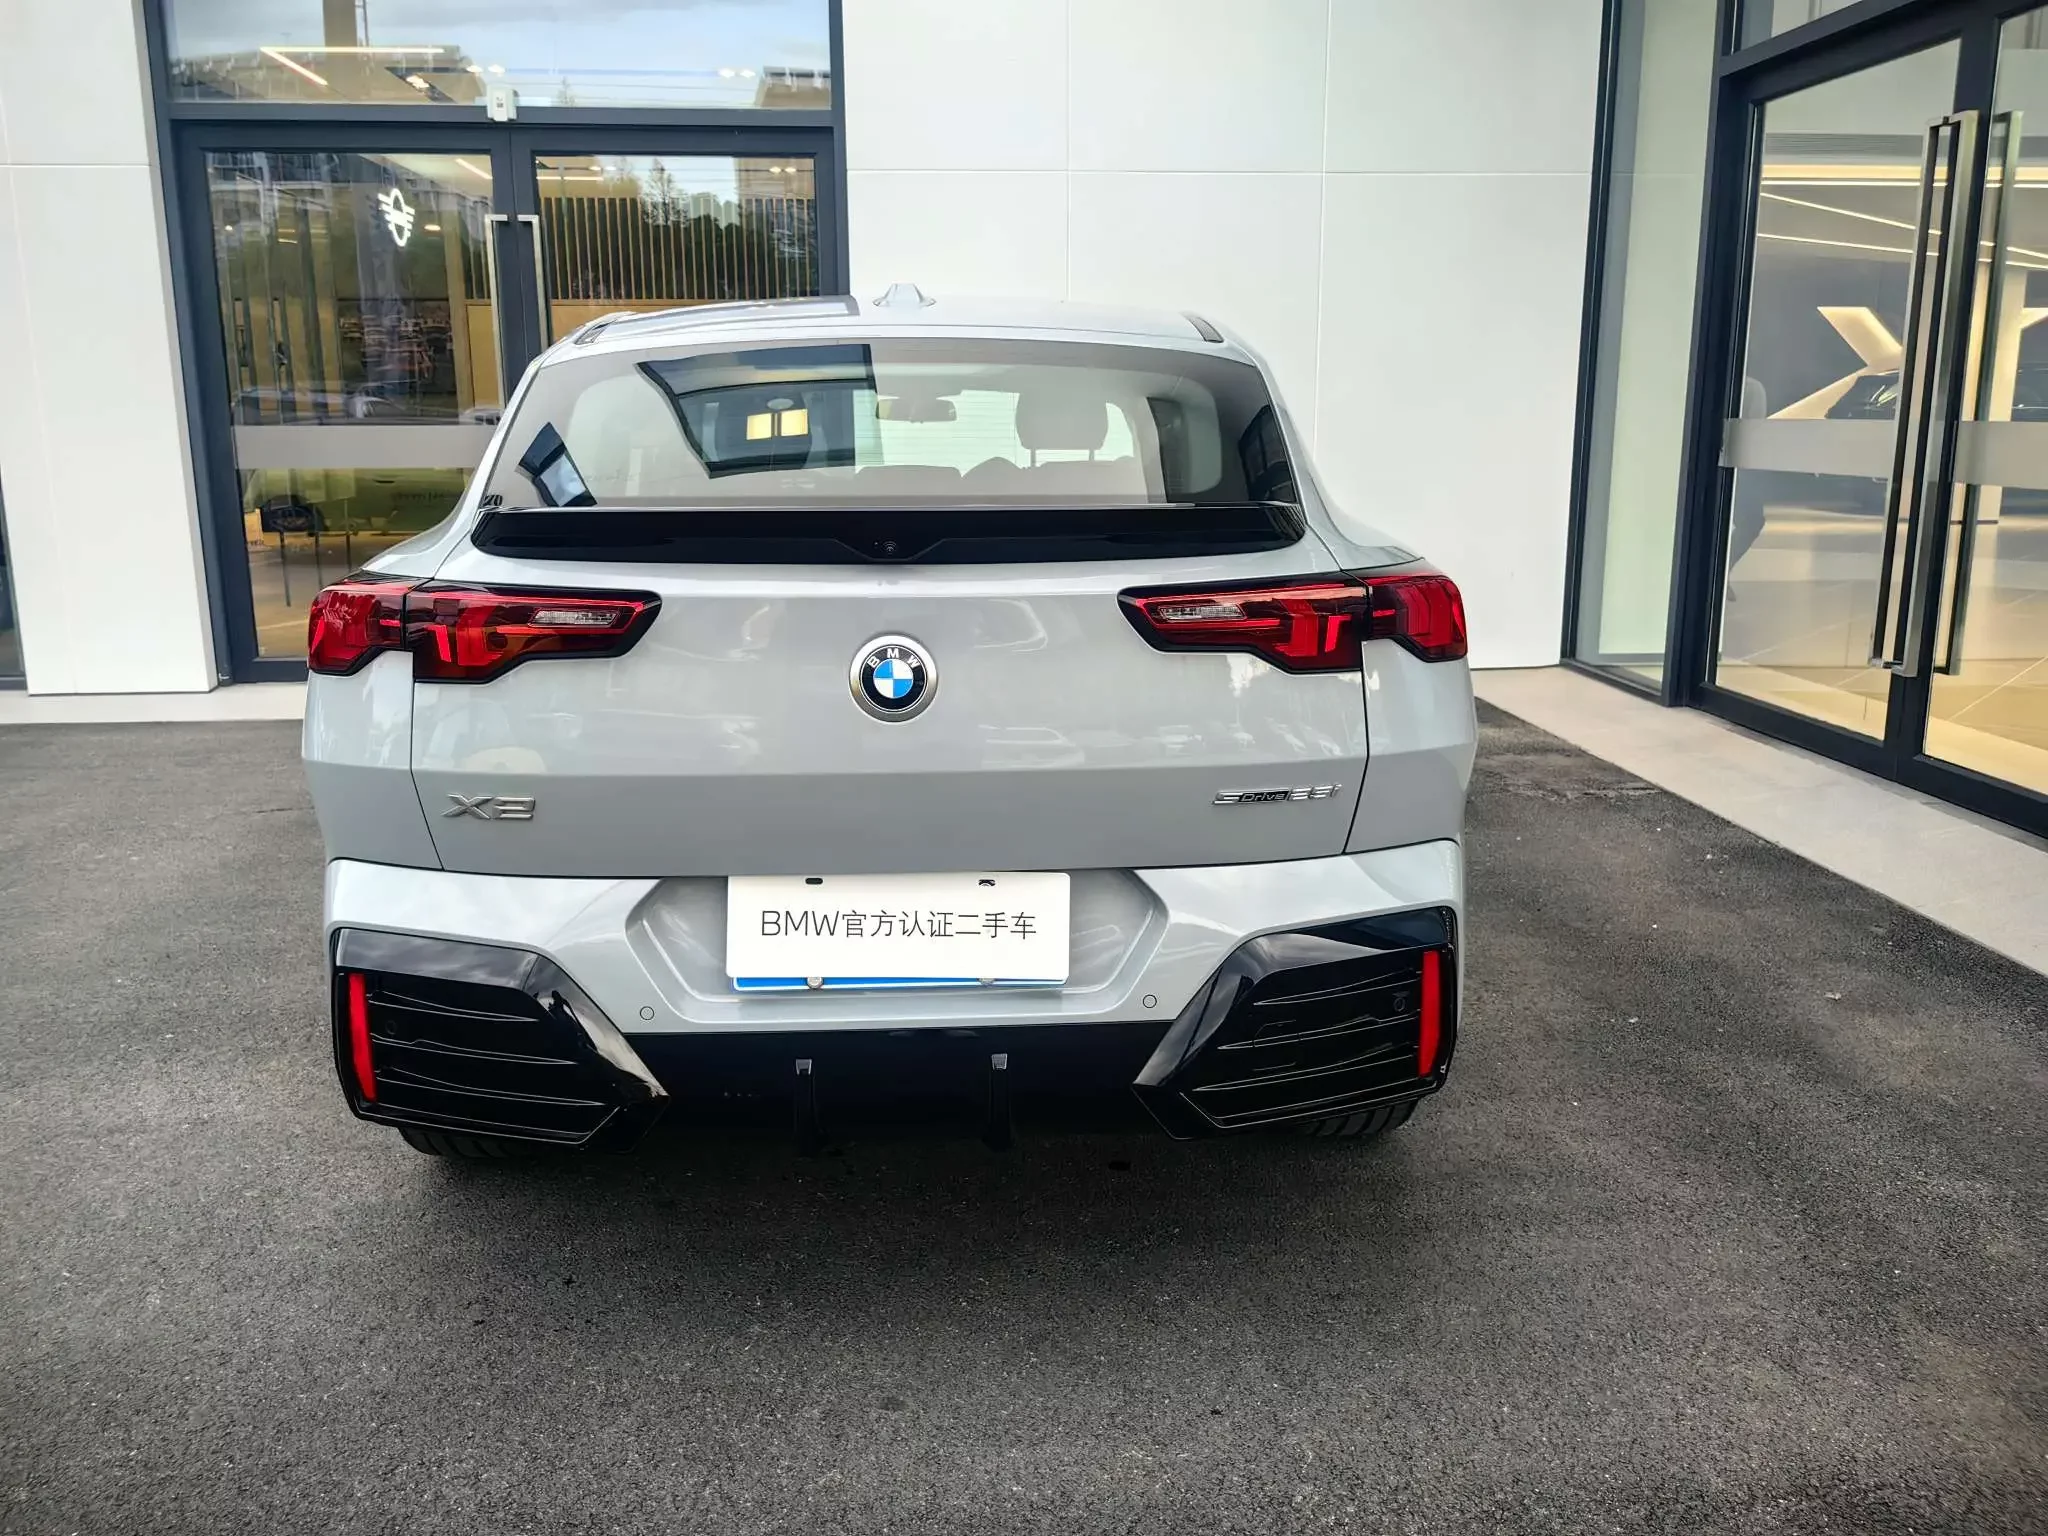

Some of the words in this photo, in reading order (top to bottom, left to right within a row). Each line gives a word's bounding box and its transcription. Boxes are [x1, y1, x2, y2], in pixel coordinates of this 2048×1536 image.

[866, 647, 921, 669] BMW
[760, 910, 1037, 940] BMW官方认证二手车
